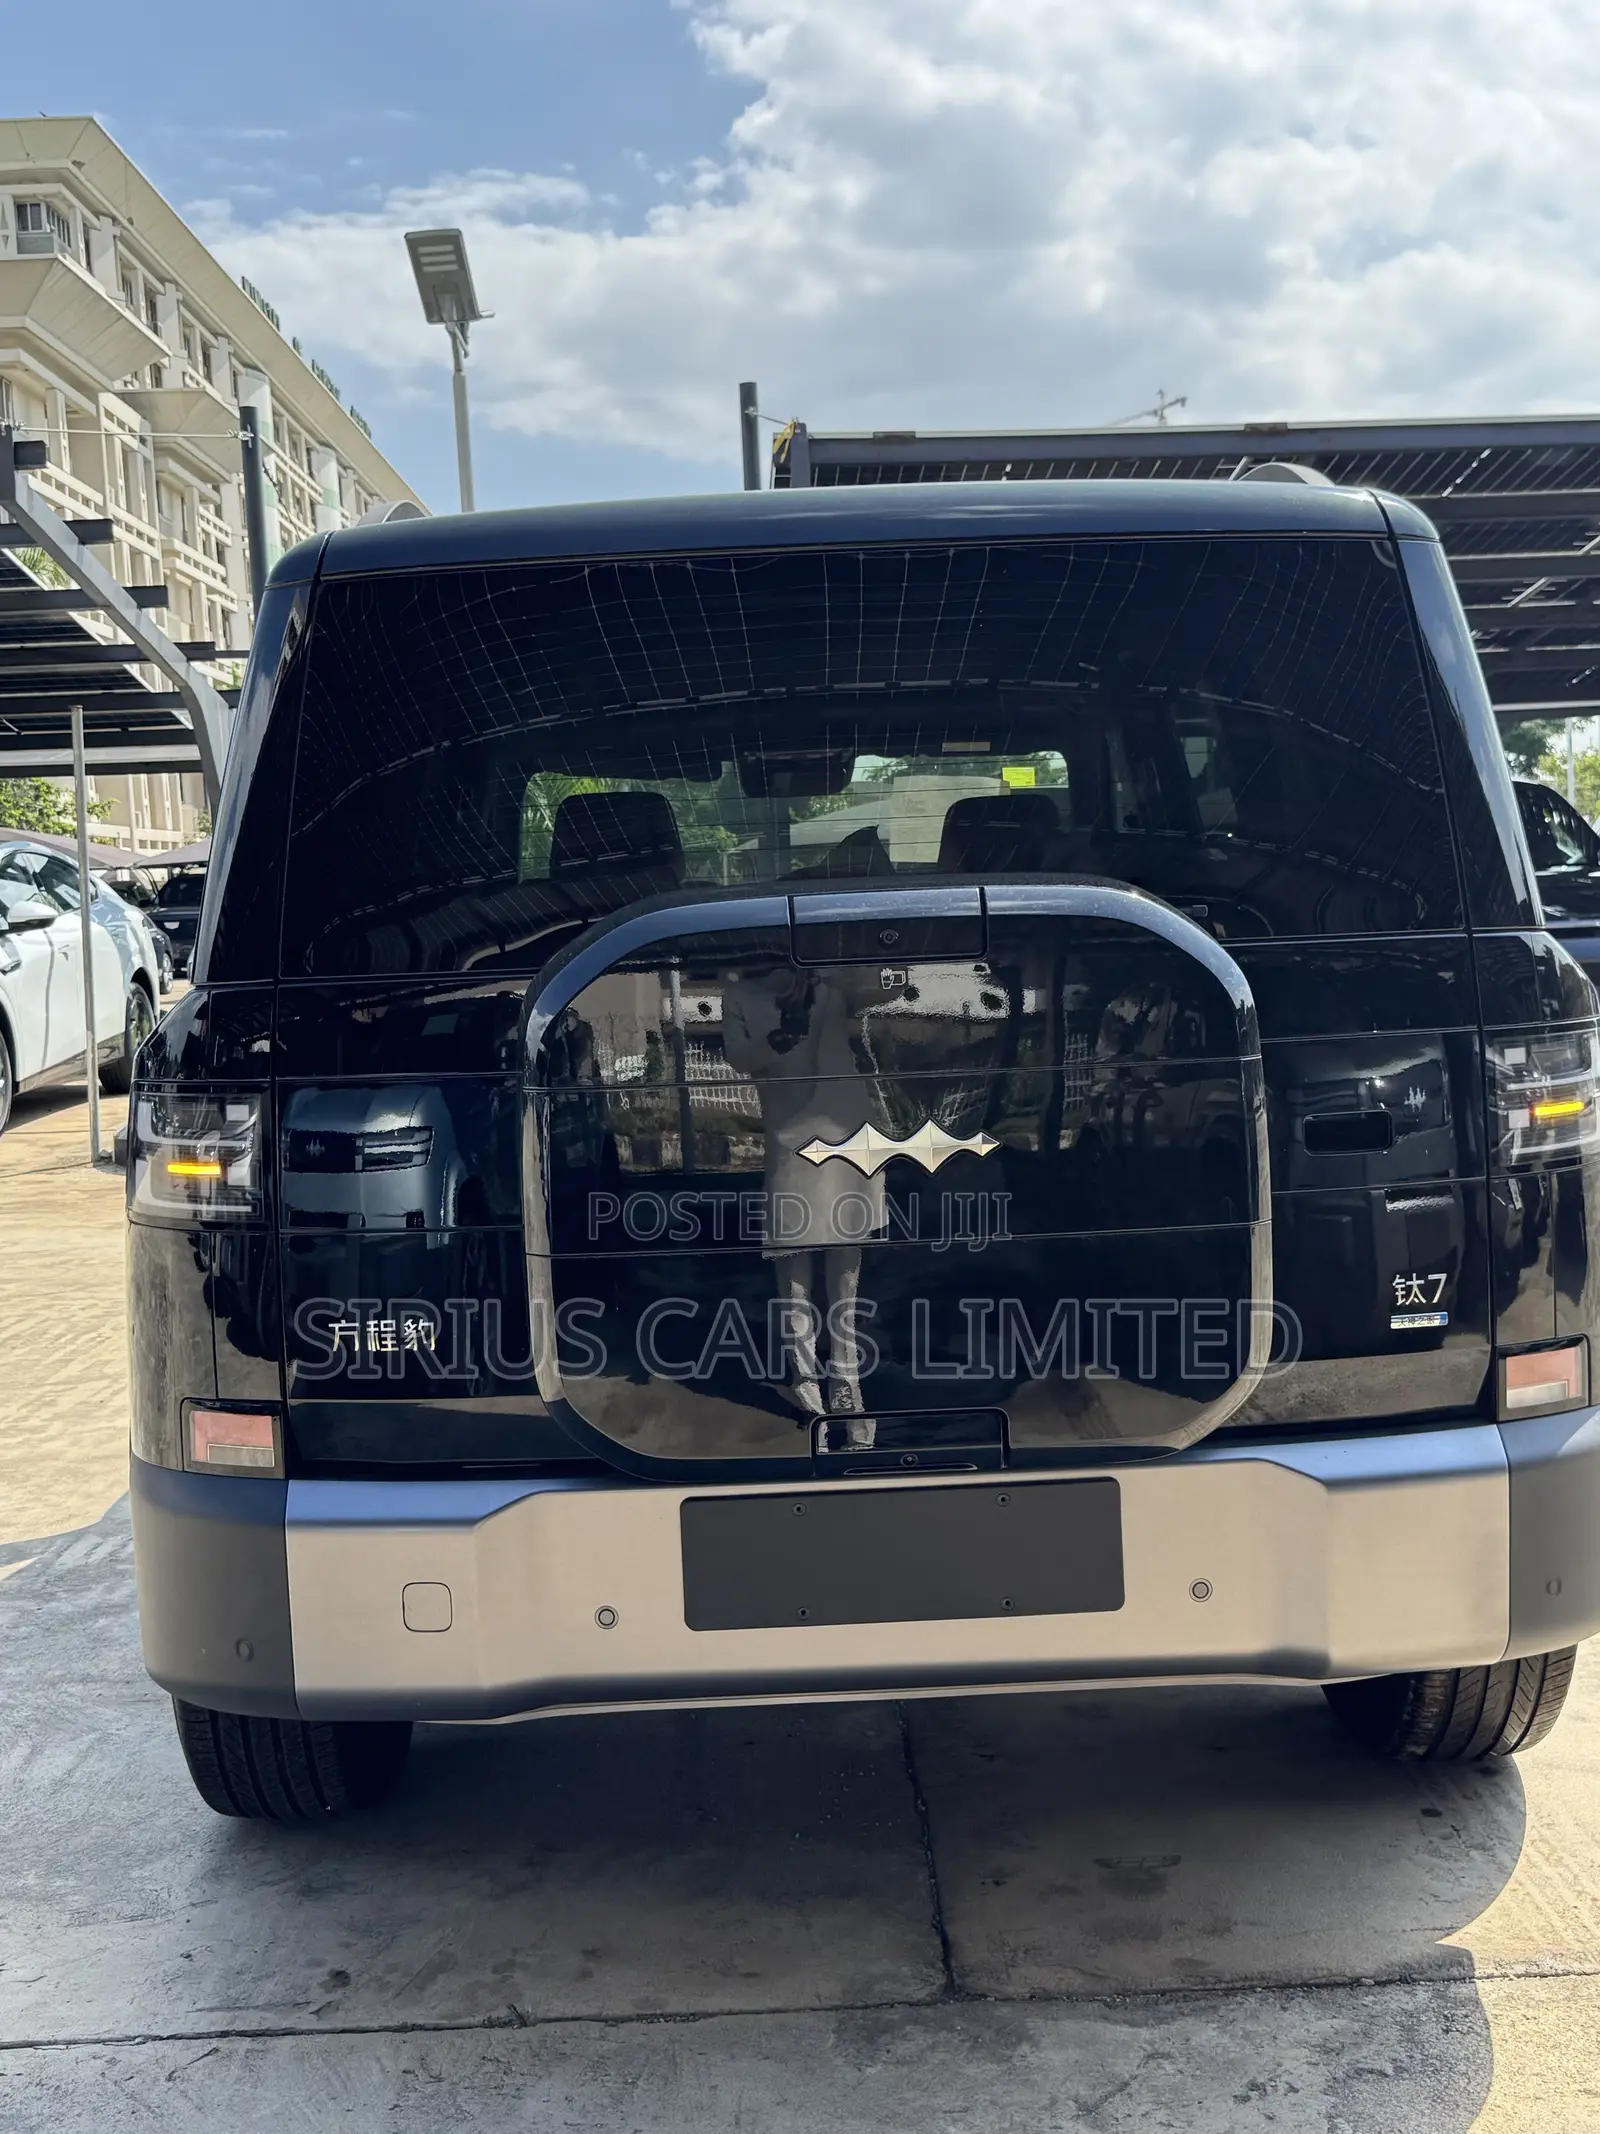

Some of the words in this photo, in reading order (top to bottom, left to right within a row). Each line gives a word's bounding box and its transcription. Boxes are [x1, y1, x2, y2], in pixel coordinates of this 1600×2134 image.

[1392, 1272, 1447, 1306] 钛7
[328, 1318, 436, 1352] 方程豹
